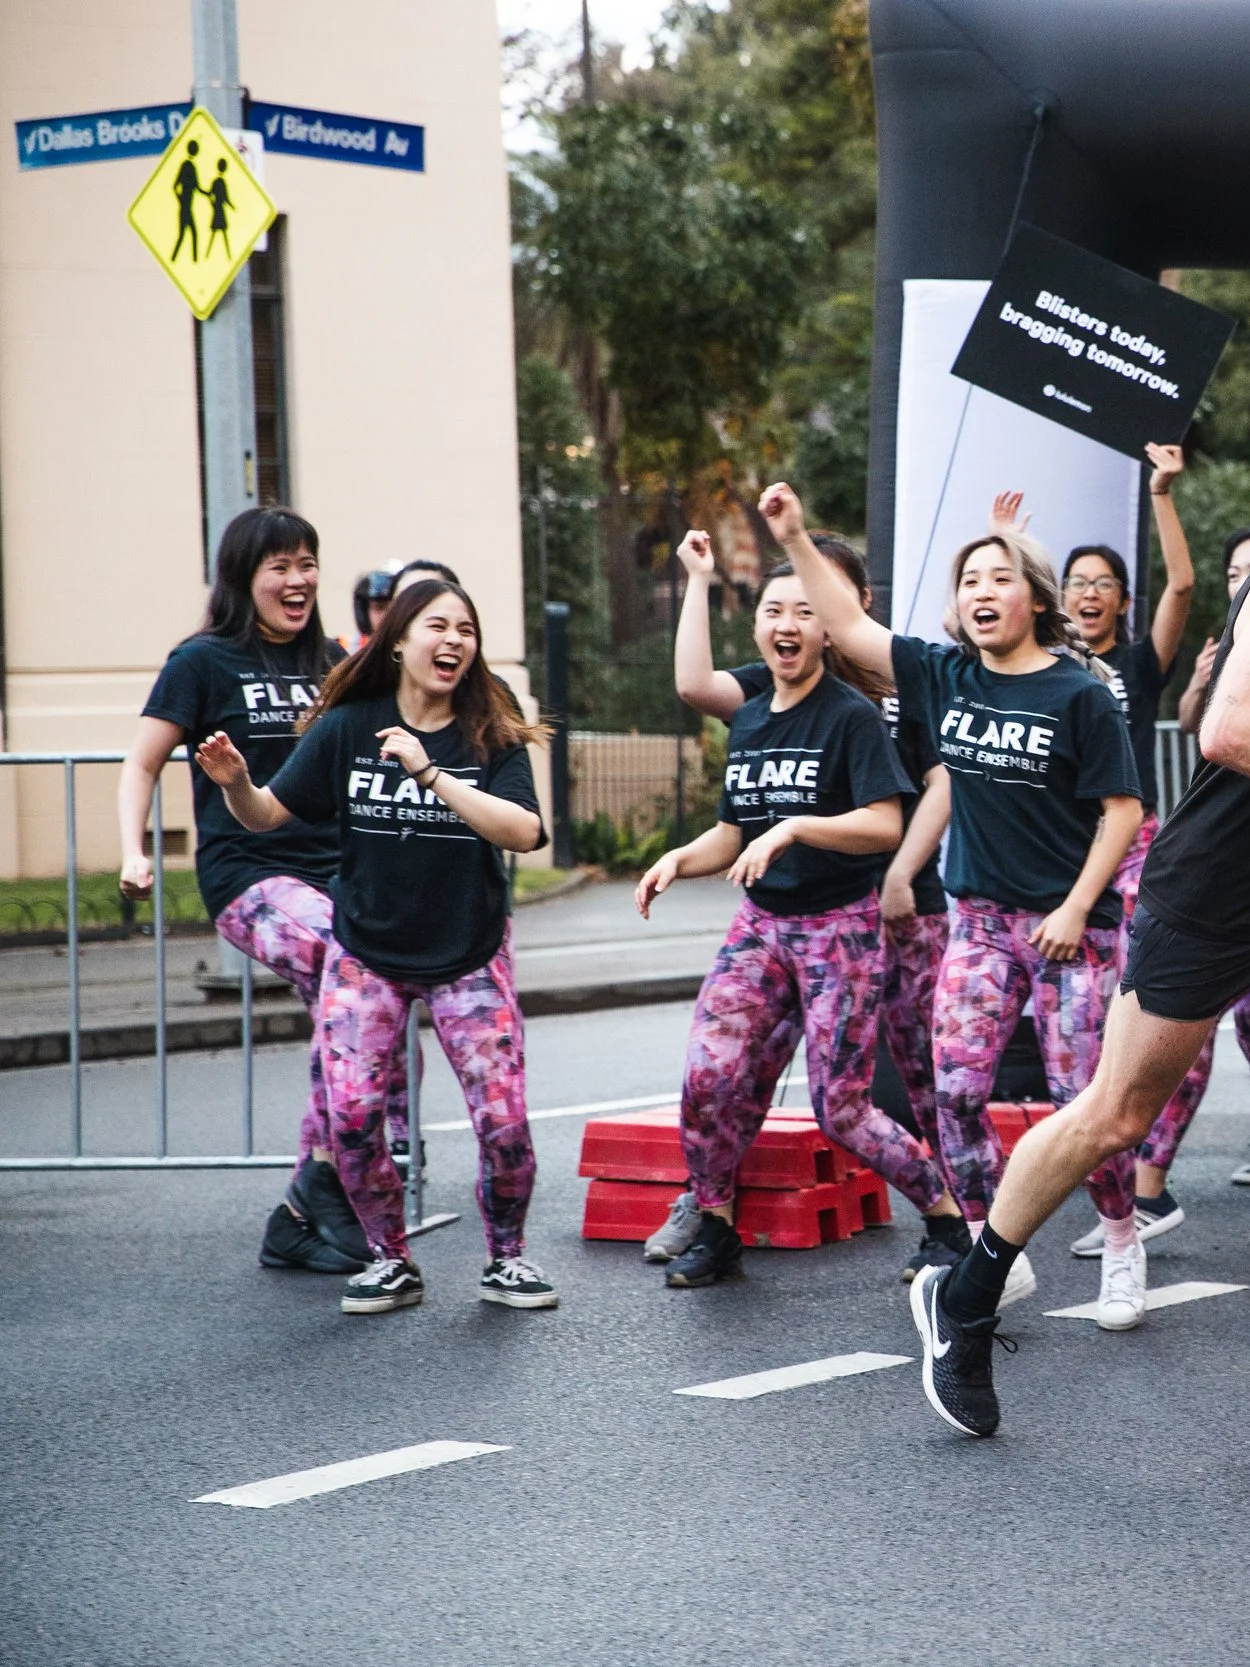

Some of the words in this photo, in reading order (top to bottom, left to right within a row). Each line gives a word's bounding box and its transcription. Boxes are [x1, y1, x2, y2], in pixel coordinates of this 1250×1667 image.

[38, 123, 94, 152] Dallas
[97, 117, 165, 146] Brooks
[168, 110, 189, 138] D
[282, 113, 377, 152] Birdwood
[384, 129, 410, 157] Av
[1035, 289, 1108, 336] Blisters
[1109, 325, 1166, 366] today,
[999, 301, 1085, 357] bragging
[1086, 343, 1180, 399] tomorrow.
[242, 682, 321, 709] FLA
[248, 710, 296, 724] DANCE
[940, 709, 1054, 757] FLARE
[725, 760, 820, 791] FLARE
[976, 750, 1049, 774] ENSEMBLE
[348, 803, 392, 819] DANCE
[396, 807, 467, 823] ENSEMB
